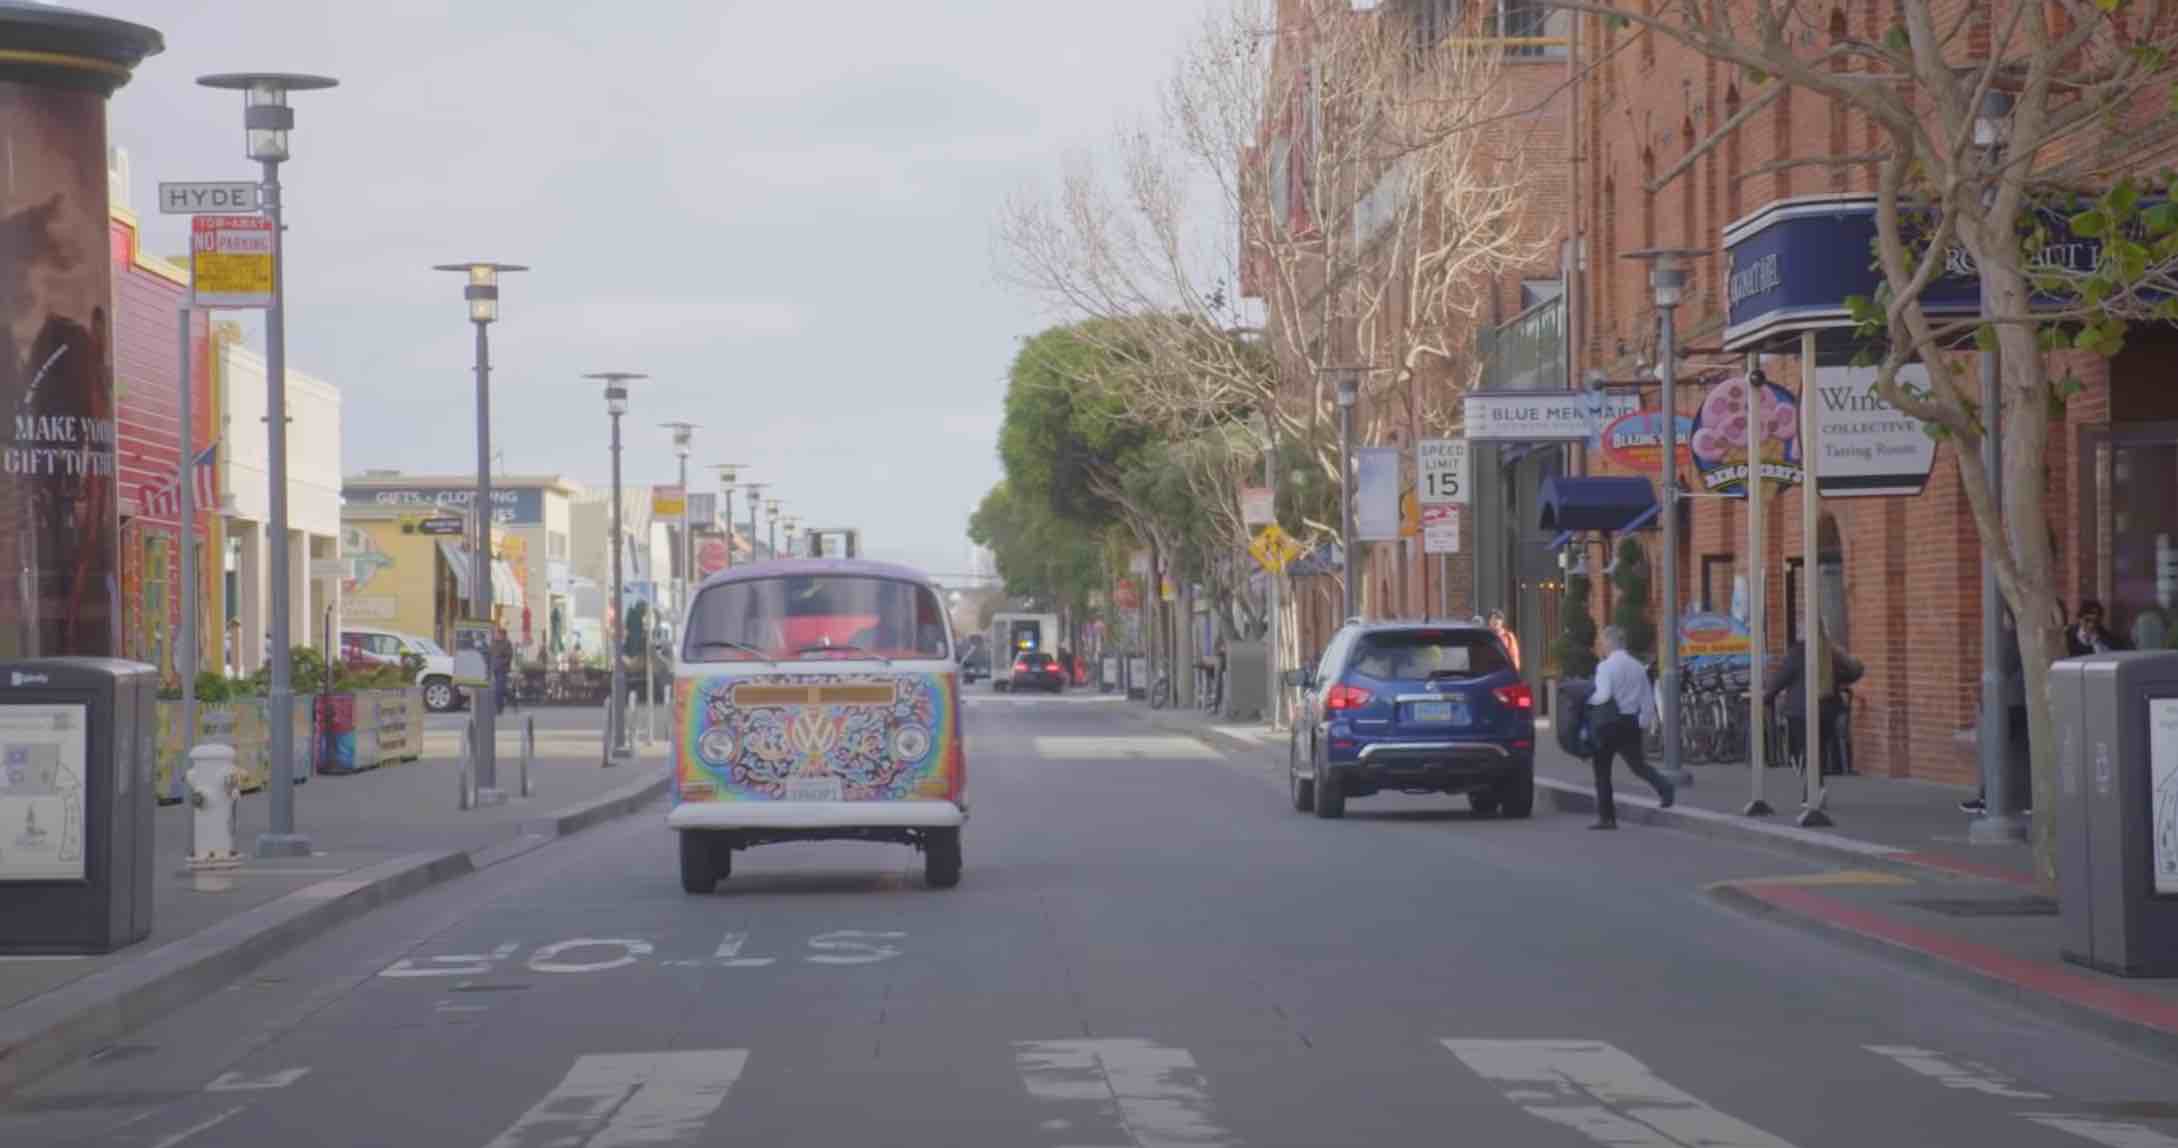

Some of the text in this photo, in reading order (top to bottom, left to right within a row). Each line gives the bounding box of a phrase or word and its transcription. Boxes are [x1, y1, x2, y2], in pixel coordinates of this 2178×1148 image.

[169, 189, 246, 206] HYDE
[194, 232, 215, 250] NO
[1493, 407, 1539, 421] BLUE
[16, 415, 77, 441] MAKE
[1821, 420, 1916, 435] COLLECTIVE
[1420, 445, 1464, 457] SPEED
[4, 447, 57, 474] GIFT
[1424, 459, 1460, 470] LIMIT
[1426, 472, 1459, 497] 15
[375, 489, 518, 506] GIFTS CLOTING
